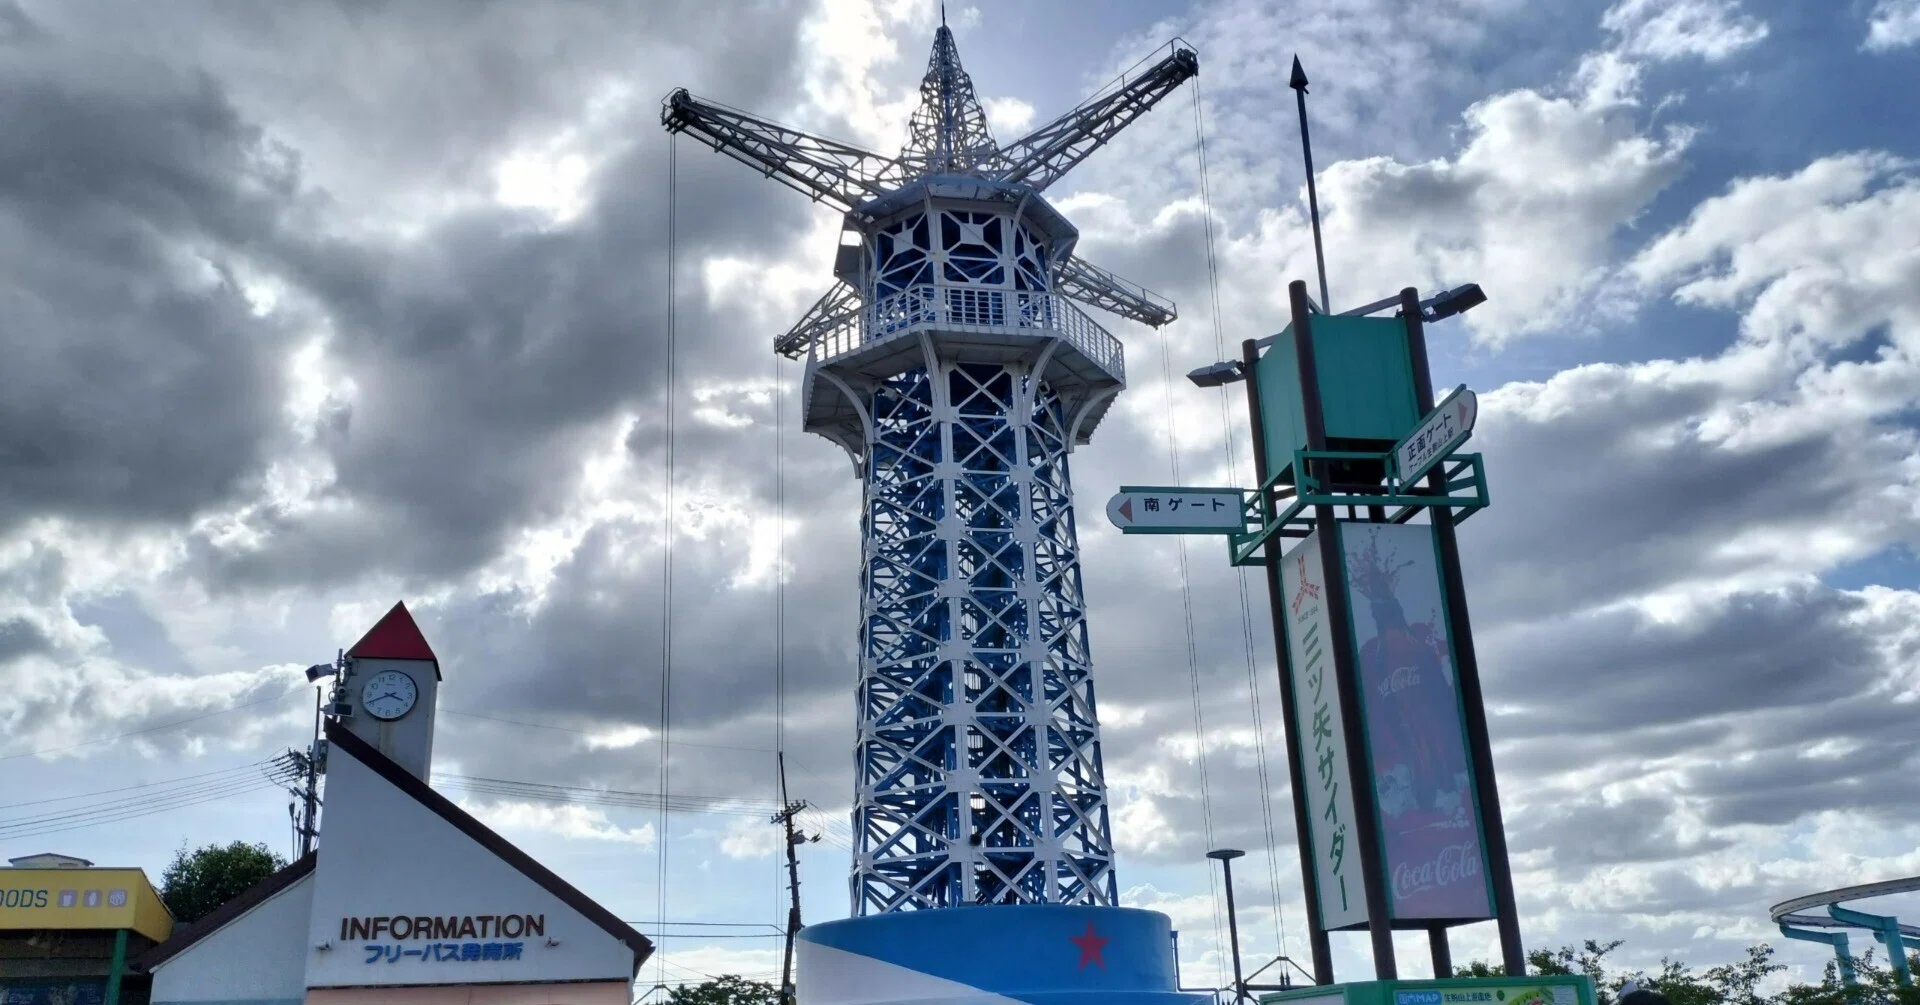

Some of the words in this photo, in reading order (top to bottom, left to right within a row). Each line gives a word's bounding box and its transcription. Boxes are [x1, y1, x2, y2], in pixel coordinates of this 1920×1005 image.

[1407, 413, 1452, 461] 正面ゲート
[1143, 497, 1225, 512] 南ゲート
[1302, 621, 1347, 911] 三ツ矢サイダー
[0, 889, 48, 908] ODS
[340, 914, 544, 940] INFORMATION
[364, 942, 524, 963] フリーパス発売所
